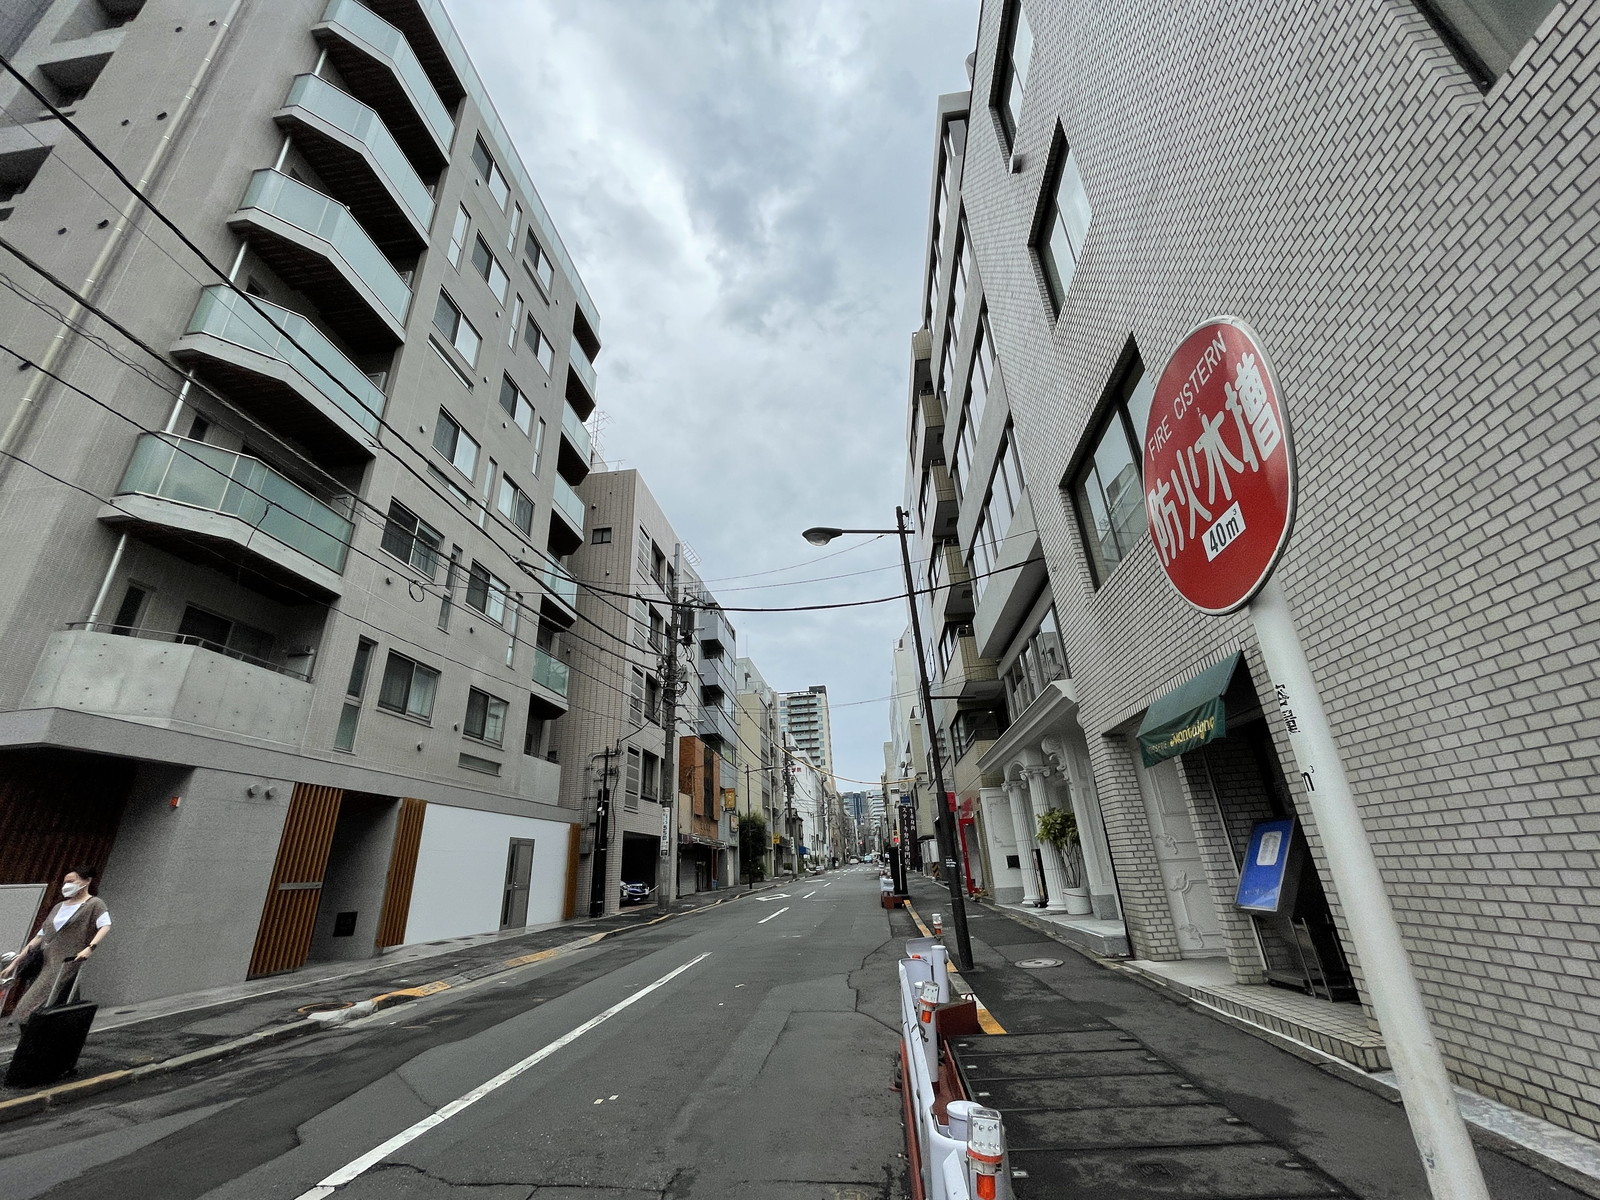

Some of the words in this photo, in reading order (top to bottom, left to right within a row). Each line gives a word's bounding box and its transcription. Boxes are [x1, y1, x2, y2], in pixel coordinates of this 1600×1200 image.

[1148, 414, 1173, 461] FIRE
[1173, 331, 1227, 420] CISTERN
[1148, 351, 1282, 567] 防火水槽
